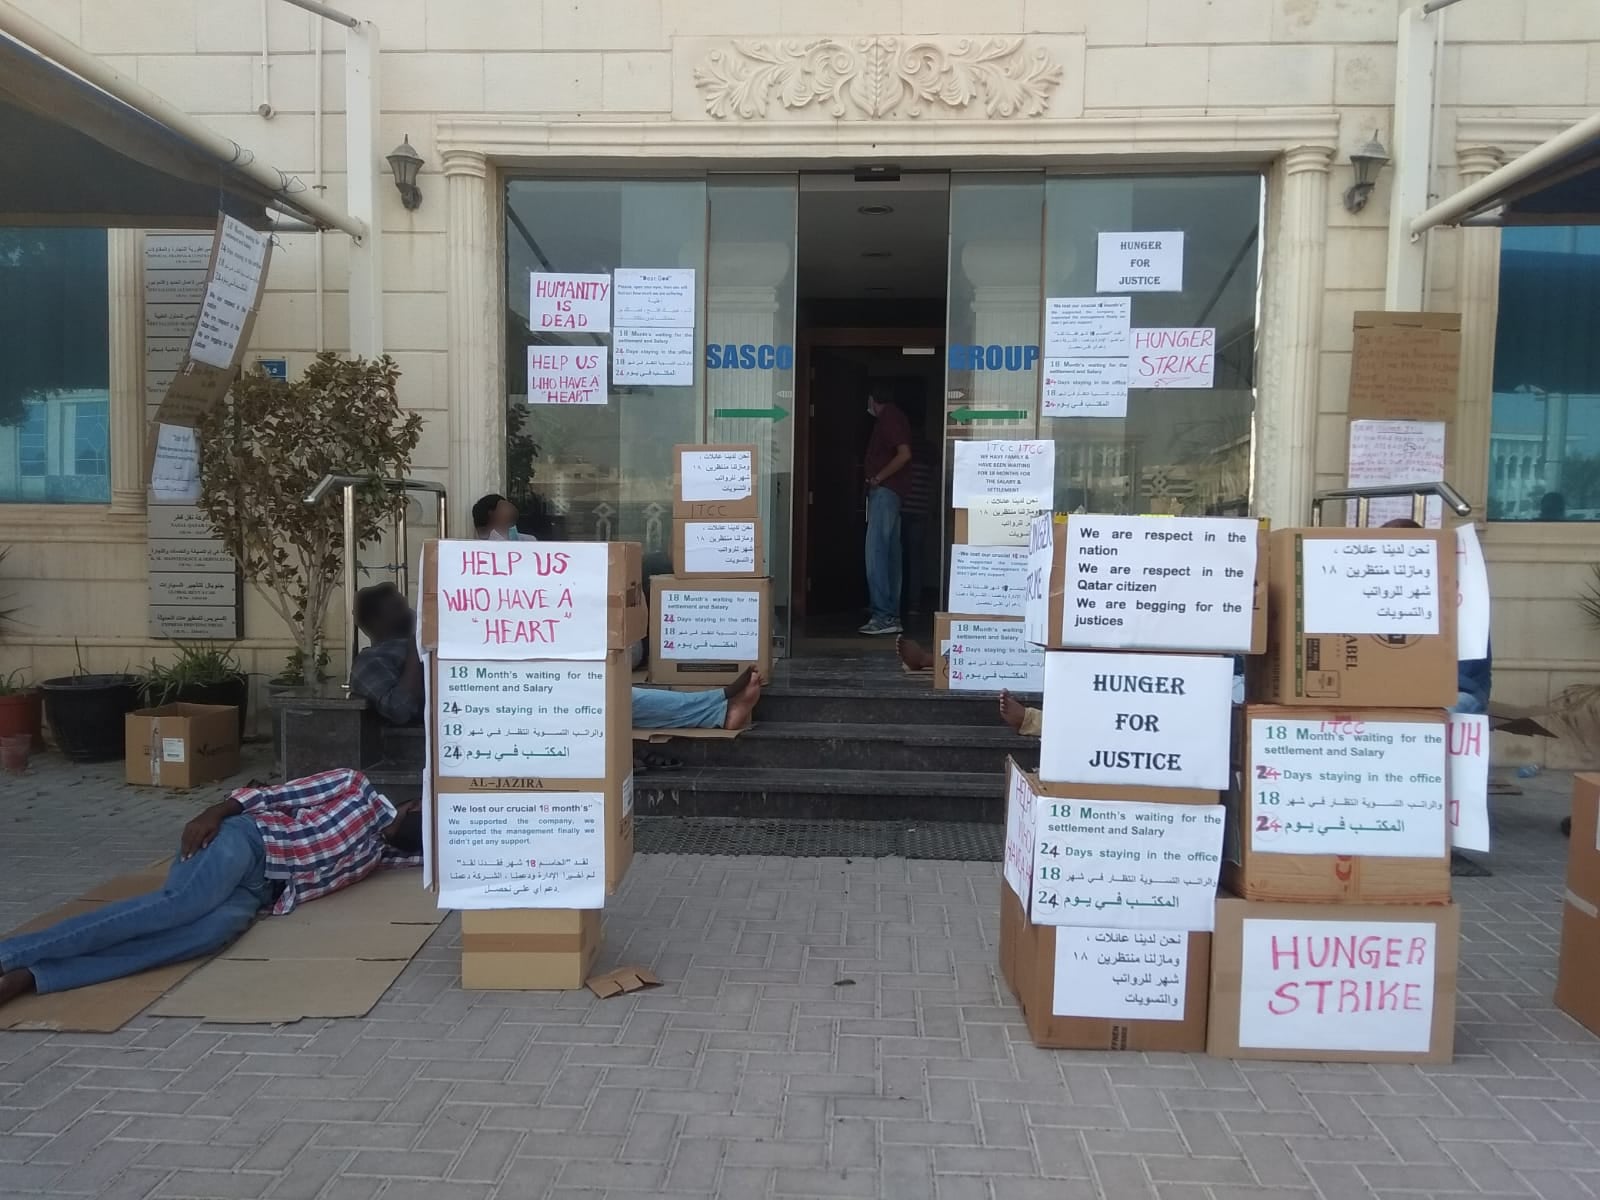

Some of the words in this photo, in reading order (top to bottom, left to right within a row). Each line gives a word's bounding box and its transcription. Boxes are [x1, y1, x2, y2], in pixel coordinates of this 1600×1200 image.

[1120, 241, 1162, 250] HUNGER
[1130, 259, 1150, 268] FOR
[1119, 276, 1160, 285] JUSTICE
[536, 280, 609, 301] HUMANITY
[557, 301, 572, 311] IS
[541, 313, 588, 328] DEAD
[1135, 329, 1213, 349] HUNGER
[532, 354, 569, 370] HELP
[575, 355, 599, 369] US
[707, 344, 793, 369] SASCO
[949, 344, 1040, 371] GROUP
[1139, 354, 1213, 377] STRIKE
[532, 376, 557, 390] WHO
[560, 376, 587, 389] HAVE
[589, 376, 599, 387] A
[1080, 527, 1100, 539] We
[1111, 530, 1133, 540] are
[1145, 529, 1193, 543] respect
[1204, 531, 1216, 542] in
[1228, 532, 1247, 543] the
[1079, 545, 1118, 556] nation
[461, 551, 522, 576] HELP
[532, 552, 571, 576] US
[1079, 563, 1098, 574] We
[1110, 565, 1131, 575] are
[1143, 564, 1191, 577] respect
[1202, 566, 1213, 577] in
[1225, 567, 1244, 578] the
[1077, 579, 1113, 591] Qatar
[1116, 580, 1157, 592] citizen
[442, 588, 490, 612] WHO
[496, 588, 549, 610] HAVE
[557, 588, 573, 609] A
[1076, 598, 1096, 609] We
[1105, 600, 1127, 609] are
[1136, 599, 1186, 613] begging
[1196, 601, 1213, 612] for
[1223, 602, 1242, 613] the
[1074, 615, 1124, 627] justices
[450, 666, 468, 679] 18
[476, 668, 518, 679] Month's
[526, 670, 561, 681] waiting
[567, 671, 581, 679] for
[588, 671, 603, 680] the
[449, 684, 499, 692] settlement
[502, 684, 520, 692] and
[523, 684, 553, 694] Salary
[1093, 674, 1186, 695] HUNGER
[443, 701, 462, 715] 24
[465, 705, 490, 715] Days
[496, 705, 533, 715] staying
[539, 705, 548, 714] in
[553, 705, 569, 714] the
[575, 705, 603, 715] office
[1115, 713, 1160, 733] FOR
[1265, 726, 1287, 740] 18
[1296, 728, 1345, 741] Month's
[1353, 733, 1393, 744] waiting
[1401, 734, 1417, 743] for
[1424, 734, 1442, 743] the
[1264, 746, 1323, 756] settlement
[1326, 746, 1347, 756] and
[1350, 747, 1385, 759] Salary
[1089, 750, 1182, 771] JUSTICE
[470, 778, 544, 789] AL-JAZIRA
[1283, 769, 1313, 781] Days
[1319, 770, 1362, 783] staying
[1368, 772, 1378, 782] in
[1385, 772, 1403, 783] the
[1409, 772, 1442, 784] office
[469, 804, 487, 813] lost
[506, 804, 537, 813] crucial
[539, 804, 549, 813] 18
[1050, 804, 1071, 818] 18
[1080, 807, 1126, 821] Month's
[1135, 812, 1174, 824] waiting
[1182, 813, 1197, 823] for
[1204, 814, 1221, 825] the
[470, 818, 507, 826] supported
[558, 827, 580, 835] finally
[1048, 823, 1105, 834] settlement
[1108, 826, 1128, 835] and
[1131, 826, 1165, 837] Salary
[472, 838, 484, 846] get
[1040, 843, 1060, 858] 24
[1065, 847, 1093, 858] Days
[1100, 848, 1141, 861] staying
[1147, 849, 1157, 860] in
[1164, 850, 1181, 860] the
[1188, 851, 1218, 862] office
[1271, 935, 1427, 971] HUNGER
[1268, 979, 1423, 1016] STRIKE
